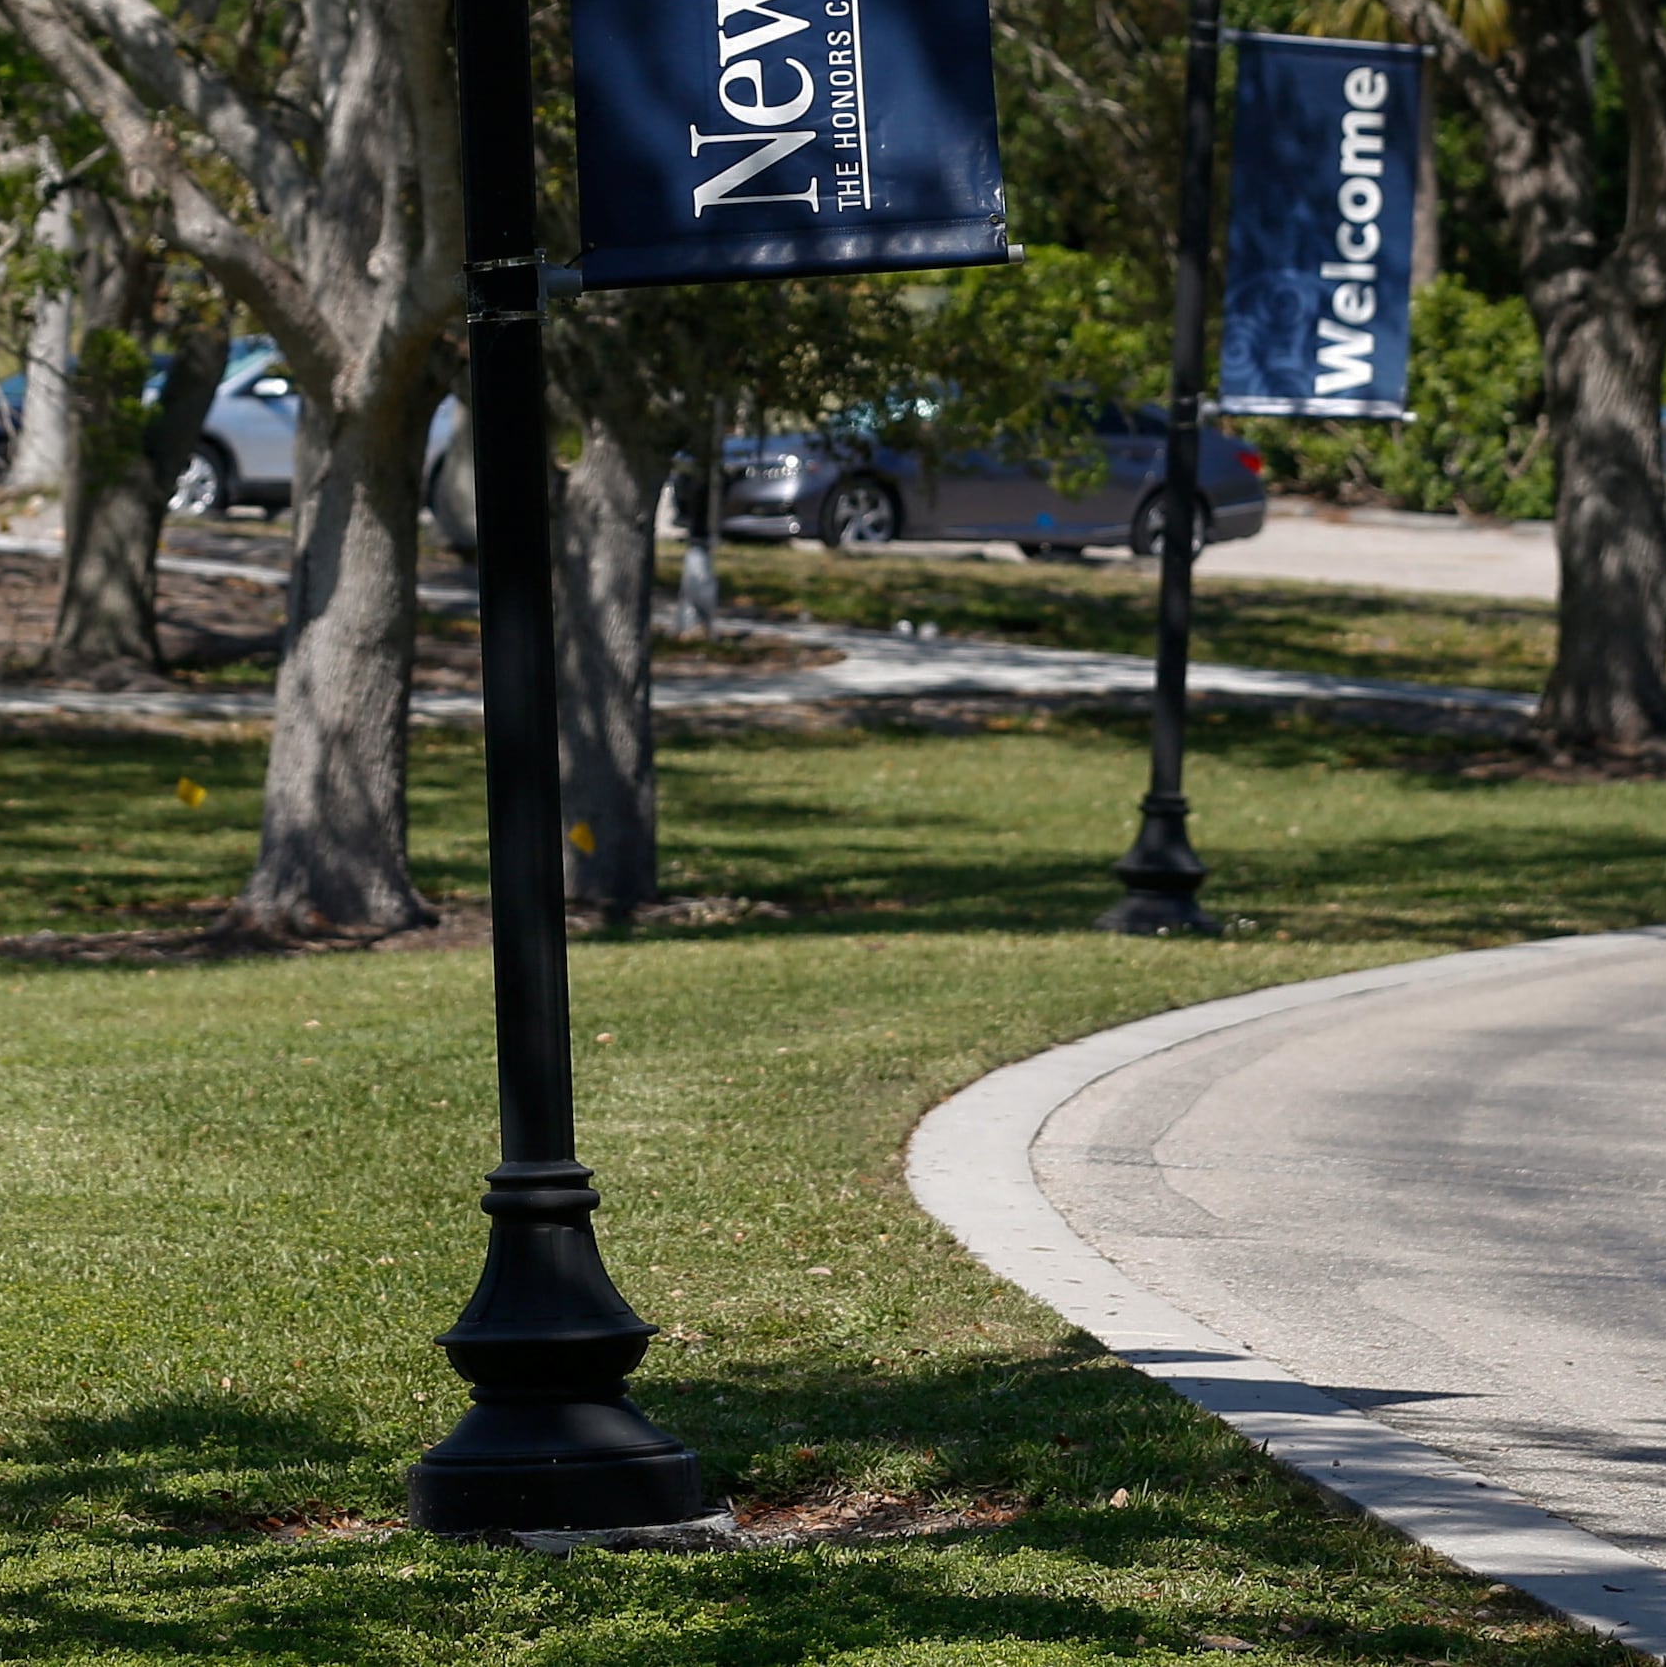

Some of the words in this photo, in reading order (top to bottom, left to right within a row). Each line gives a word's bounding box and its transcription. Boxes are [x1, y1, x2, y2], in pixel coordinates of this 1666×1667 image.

[826, 30, 858, 149] HONORS
[835, 161, 862, 213] THE
[1313, 67, 1388, 396] Welcome
